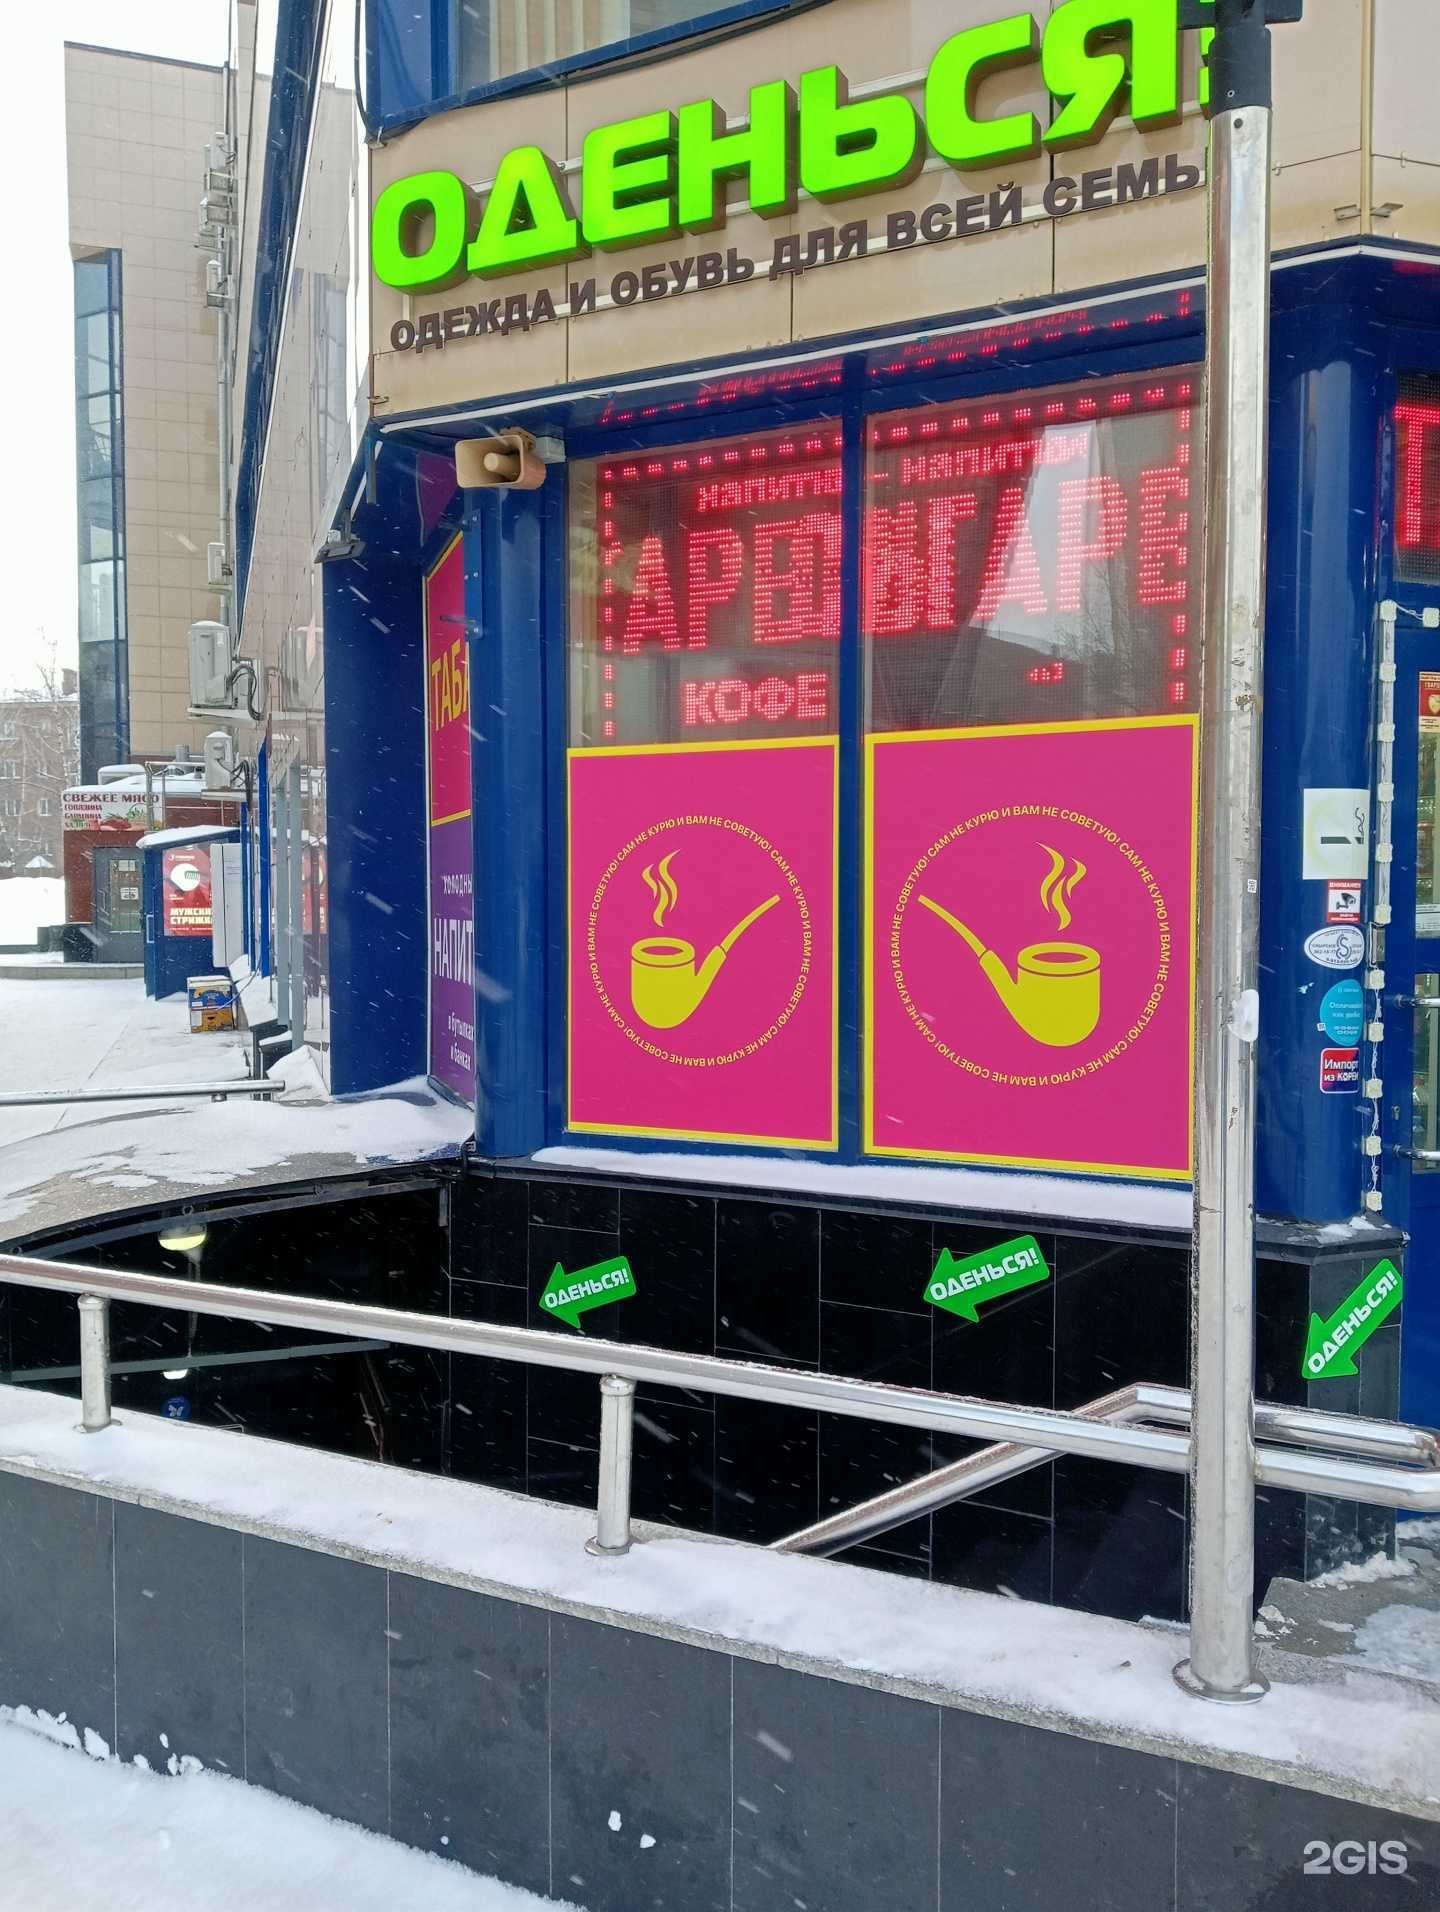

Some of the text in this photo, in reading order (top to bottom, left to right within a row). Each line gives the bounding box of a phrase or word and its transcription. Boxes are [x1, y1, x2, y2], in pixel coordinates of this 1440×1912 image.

[391, 154, 1200, 354] ОДЕЖДА И ОБУВЬ ДЛЯ ВСЕЙ СЕМЬ
[685, 673, 827, 724] КОФЕ
[63, 793, 118, 803] СВЕЖЕЕ
[616, 840, 637, 861] САМ
[634, 831, 649, 845] НЕ
[647, 818, 676, 837] КУРЮ
[685, 815, 708, 825] ВАМ
[708, 815, 723, 827] НЕ
[723, 819, 773, 853] СОВЕТУЮ!
[927, 834, 951, 858] САМ
[948, 823, 966, 840] НЕ
[964, 809, 1000, 831] КУРЮ
[1012, 804, 1042, 816] ВАМ
[1040, 805, 1060, 818] НЕ
[1060, 809, 1121, 846] СОВЕТУЮ!
[770, 849, 790, 873] САМ
[1118, 842, 1144, 869] САМ
[591, 859, 620, 911] СОВЕТУЮ!
[785, 870, 799, 887] НЕ
[895, 855, 930, 913] СОВЕТУЮ!
[1137, 865, 1154, 884] НЕ
[792, 885, 810, 919] КУРЮ
[1147, 882, 1168, 920] КУРЮ
[588, 911, 598, 926] НЕ
[891, 913, 903, 930] НЕ
[434, 918, 473, 986] НАПИТ
[587, 927, 596, 952] ВАМ
[802, 930, 813, 957] ВАМ
[890, 929, 901, 958] ВАМ
[1159, 933, 1171, 963] ВАМ
[589, 962, 605, 994] КУРЮ
[800, 957, 811, 974] НЕ
[1156, 964, 1169, 982] НЕ
[599, 992, 612, 1009] НЕ
[893, 969, 912, 1005] КУРЮ
[775, 974, 807, 1028] СОВЕТУЮ!
[905, 1002, 920, 1021] НЕ
[1124, 982, 1165, 1043] СОВЕТУЮ!
[607, 1006, 625, 1029] САМ
[914, 1013, 937, 1043] САМ
[623, 1025, 669, 1061] СОВЕТУЮ!
[744, 1041, 759, 1055] НЕ
[757, 1025, 779, 1046] САМ
[668, 1053, 683, 1065] НЕ
[683, 1056, 706, 1067] ВАМ
[715, 1048, 746, 1065] КУРЮ
[933, 1040, 990, 1079] СОВЕТУЮ!
[1085, 1057, 1104, 1073] НЕ
[1102, 1040, 1128, 1064] САМ
[991, 1071, 1008, 1084] НЕ
[1009, 1074, 1037, 1087] ВАМ
[1050, 1066, 1087, 1085] КУРЮ
[544, 1267, 630, 1309] ОДЕНЬСЯ!
[930, 1246, 1041, 1303] ОДЕНЬСЯ!
[1308, 1270, 1398, 1374] ОДЕНЬСЯ!
